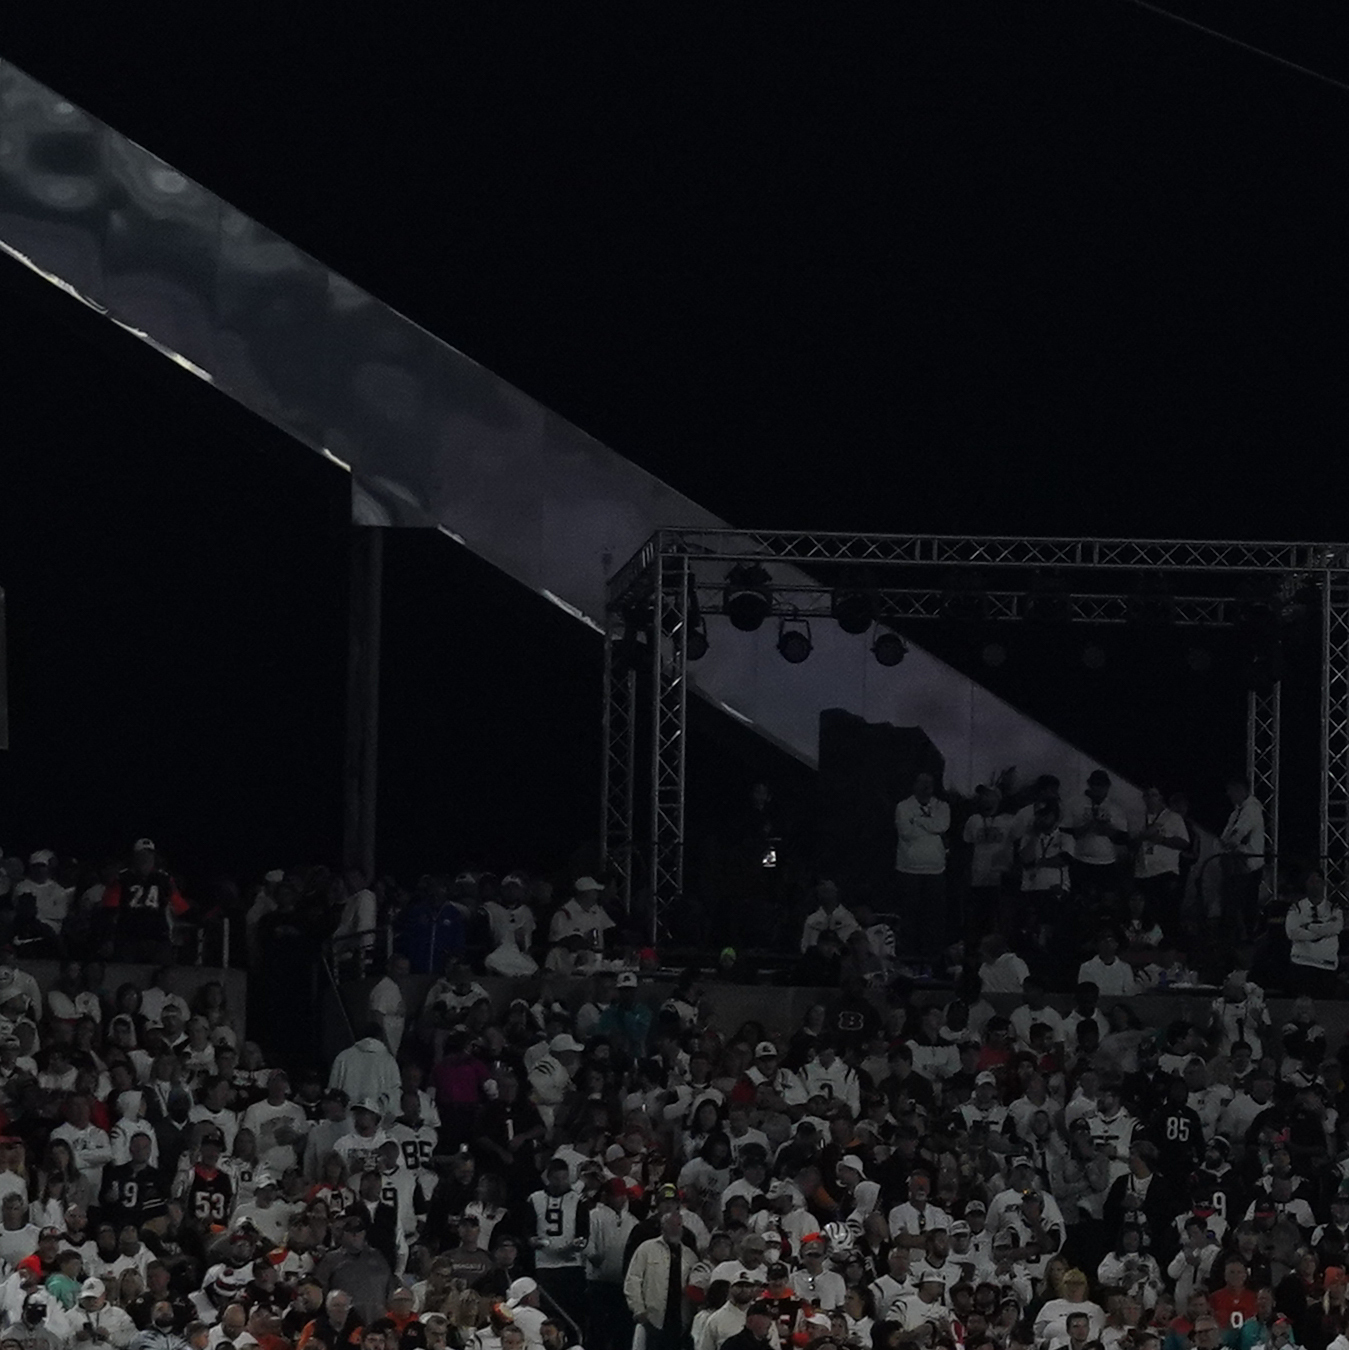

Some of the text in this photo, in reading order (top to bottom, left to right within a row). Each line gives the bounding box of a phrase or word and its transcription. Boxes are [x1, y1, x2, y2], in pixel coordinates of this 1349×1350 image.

[129, 885, 159, 908] 24
[1167, 1117, 1191, 1142] 85
[403, 1140, 434, 1170] 85
[195, 1192, 225, 1220] 53
[546, 1209, 562, 1236] 9
